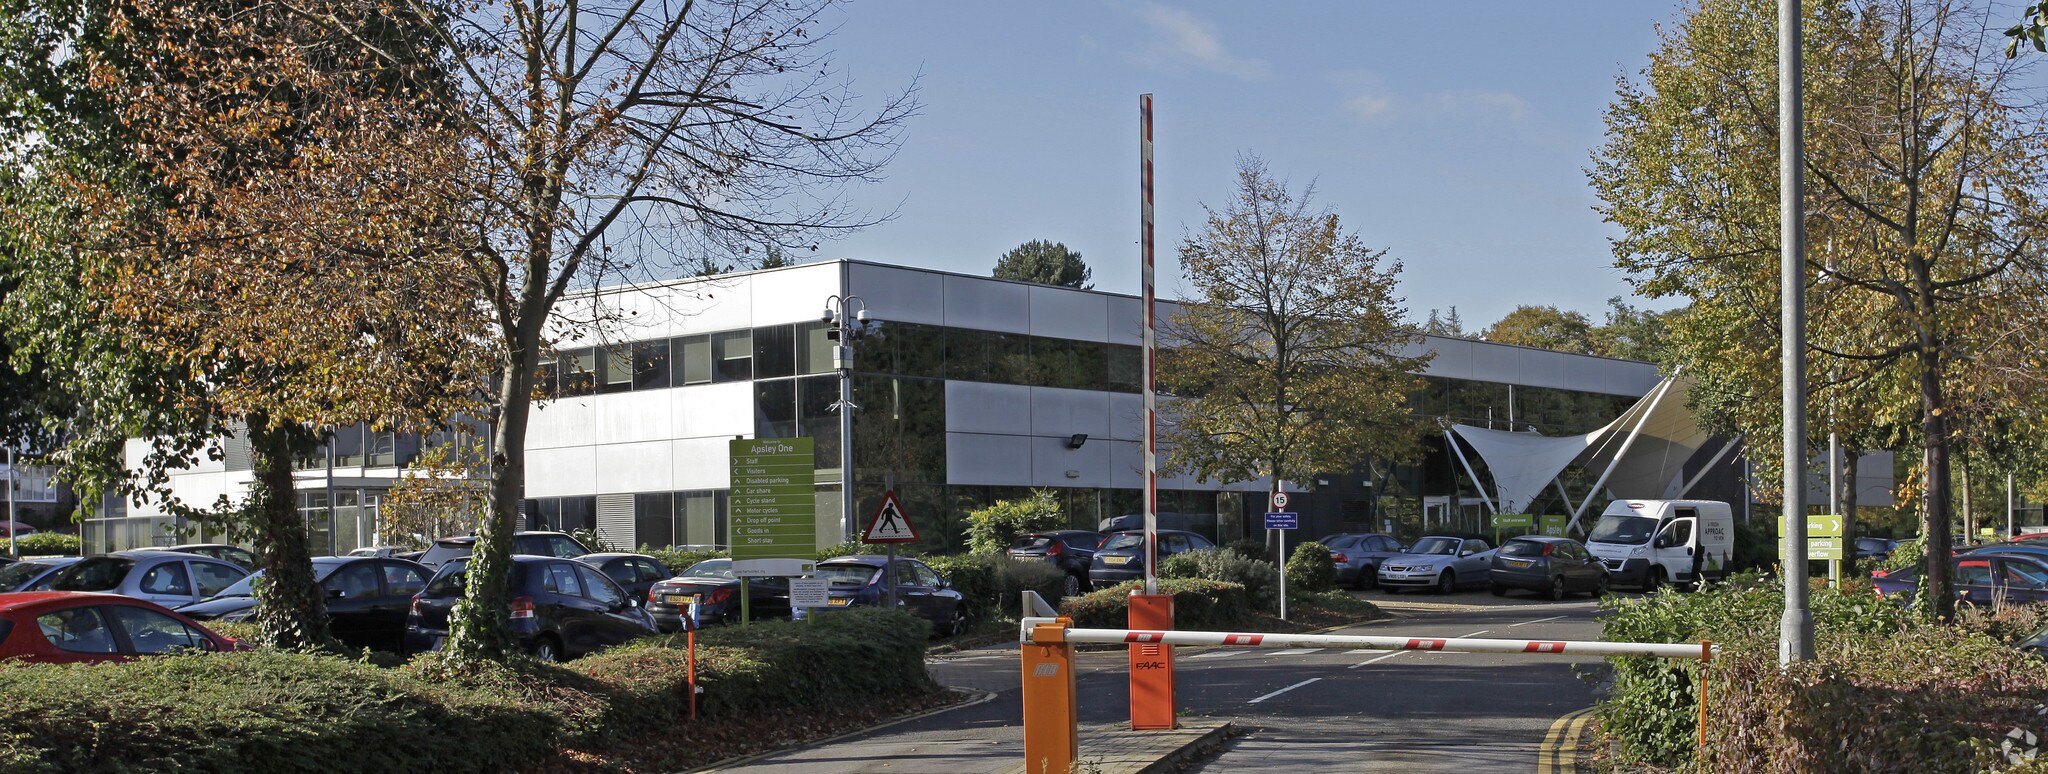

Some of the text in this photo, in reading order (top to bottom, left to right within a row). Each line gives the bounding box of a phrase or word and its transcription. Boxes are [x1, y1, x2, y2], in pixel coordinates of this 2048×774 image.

[751, 444, 794, 454] Apsley One
[1546, 525, 1562, 536] Apsley
